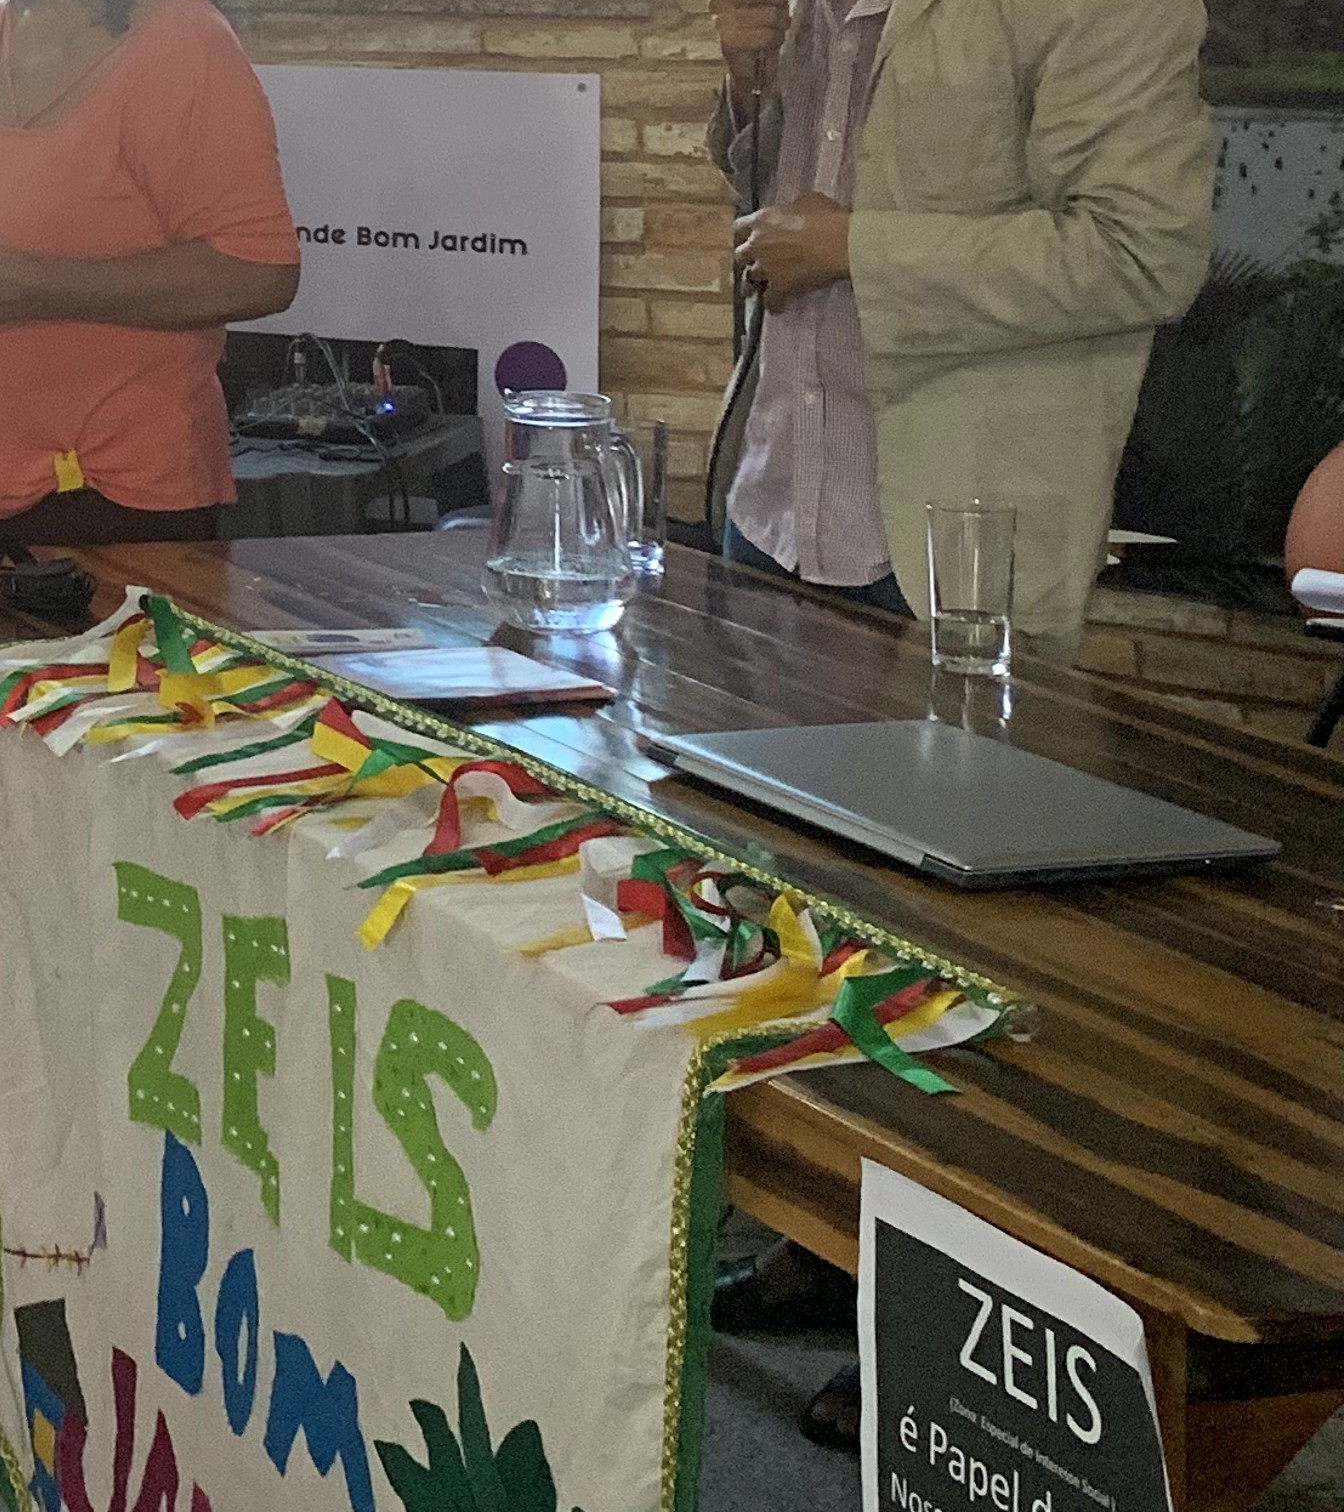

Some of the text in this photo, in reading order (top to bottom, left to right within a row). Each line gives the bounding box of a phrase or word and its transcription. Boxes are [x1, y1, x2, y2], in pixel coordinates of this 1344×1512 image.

[295, 224, 528, 256] nde Bom Jardim
[112, 861, 499, 1322] ZEIS
[154, 1128, 376, 1512] BOM
[957, 1277, 1102, 1445] ZEIS
[900, 1404, 1019, 1512] é Papel
